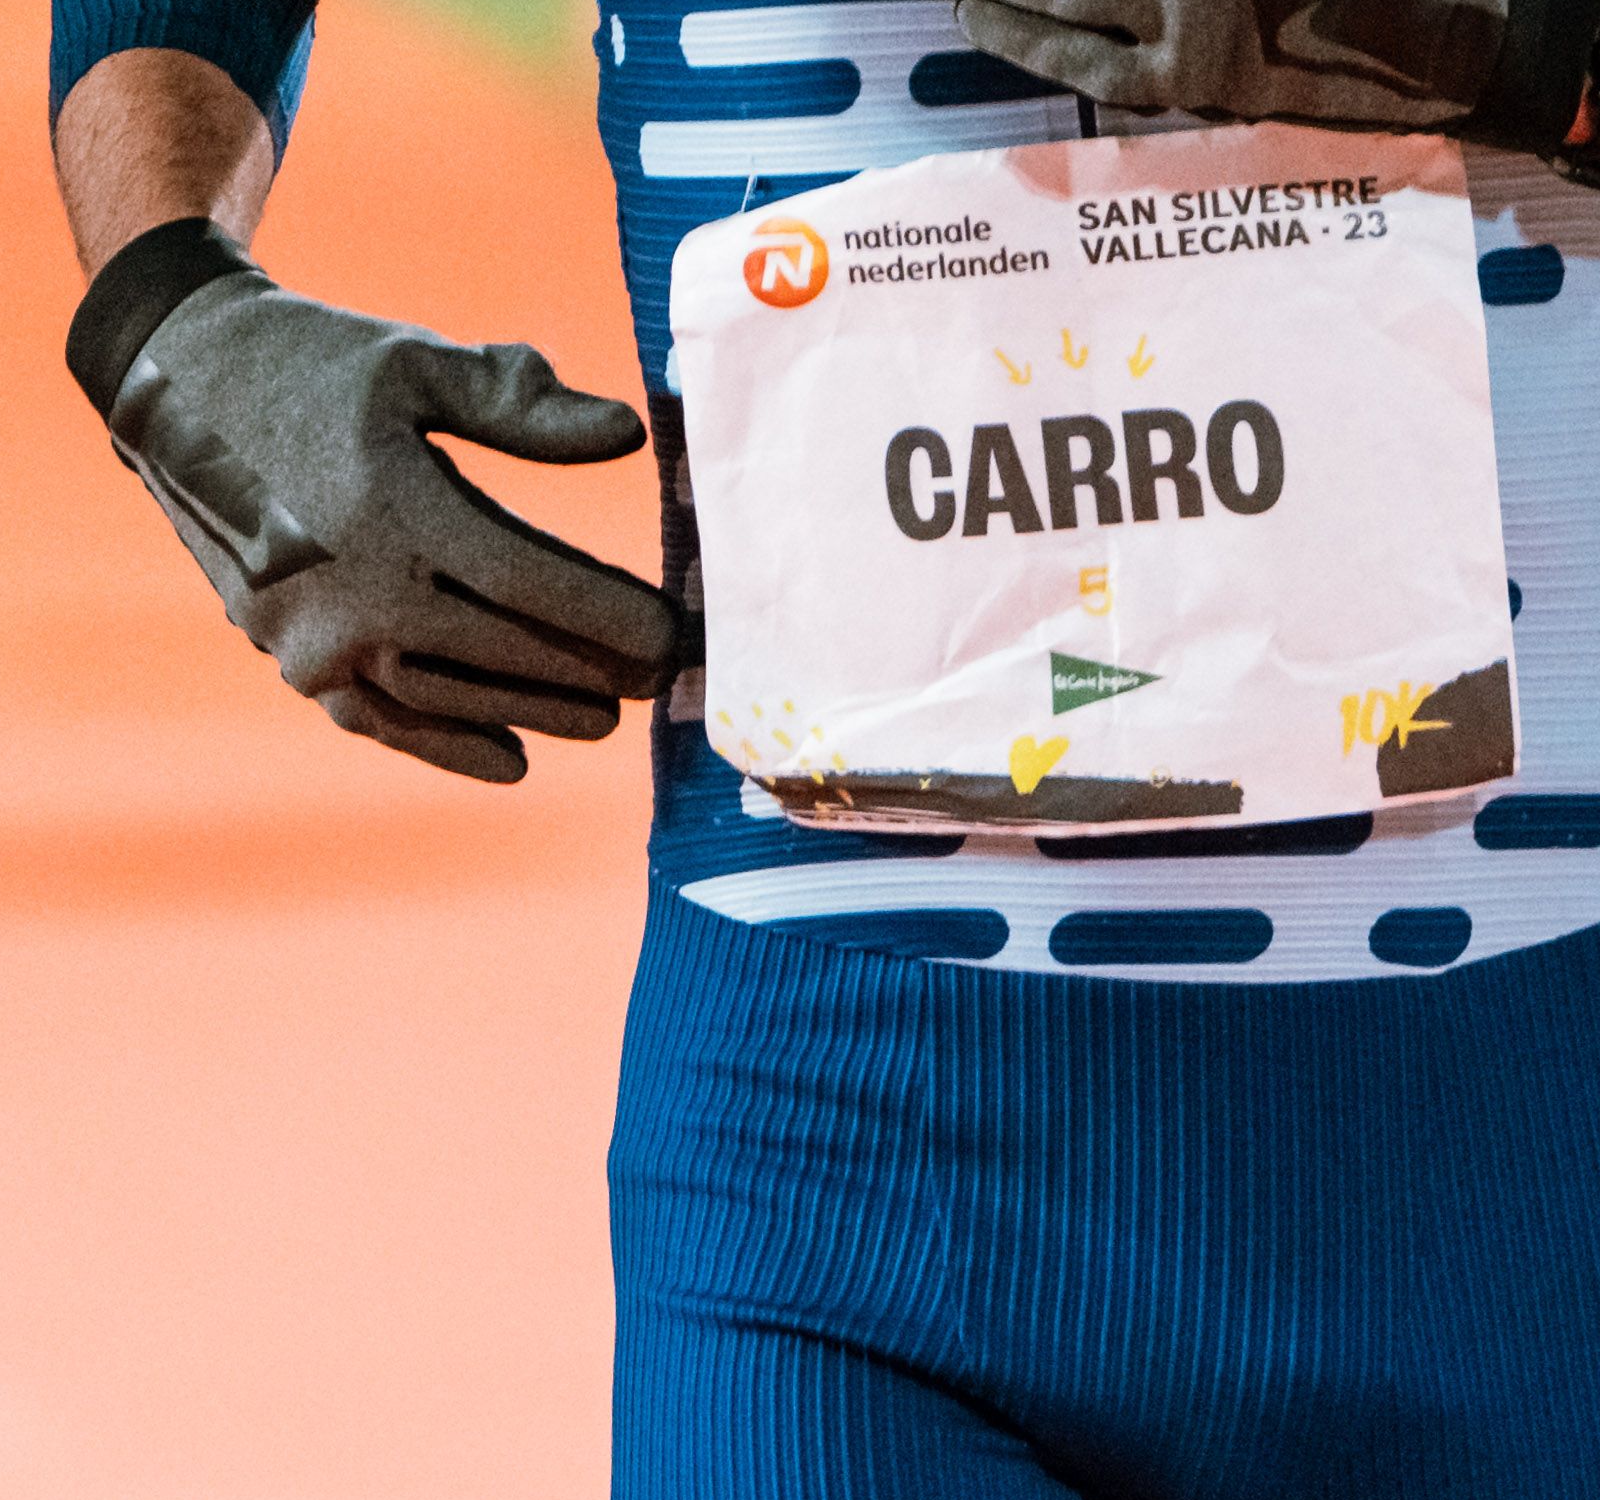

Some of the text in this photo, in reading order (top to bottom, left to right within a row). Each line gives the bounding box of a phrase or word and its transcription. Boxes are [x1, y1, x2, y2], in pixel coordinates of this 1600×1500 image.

[1078, 175, 1382, 231] SAN SILVESTRE
[844, 214, 992, 250] nationale
[1080, 217, 1311, 265] VALLECANA
[1343, 209, 1389, 241] 23
[848, 246, 1050, 285] nederlanden
[885, 399, 1285, 542] CARRO
[1079, 564, 1113, 617] 5
[1340, 681, 1453, 759] 10K
